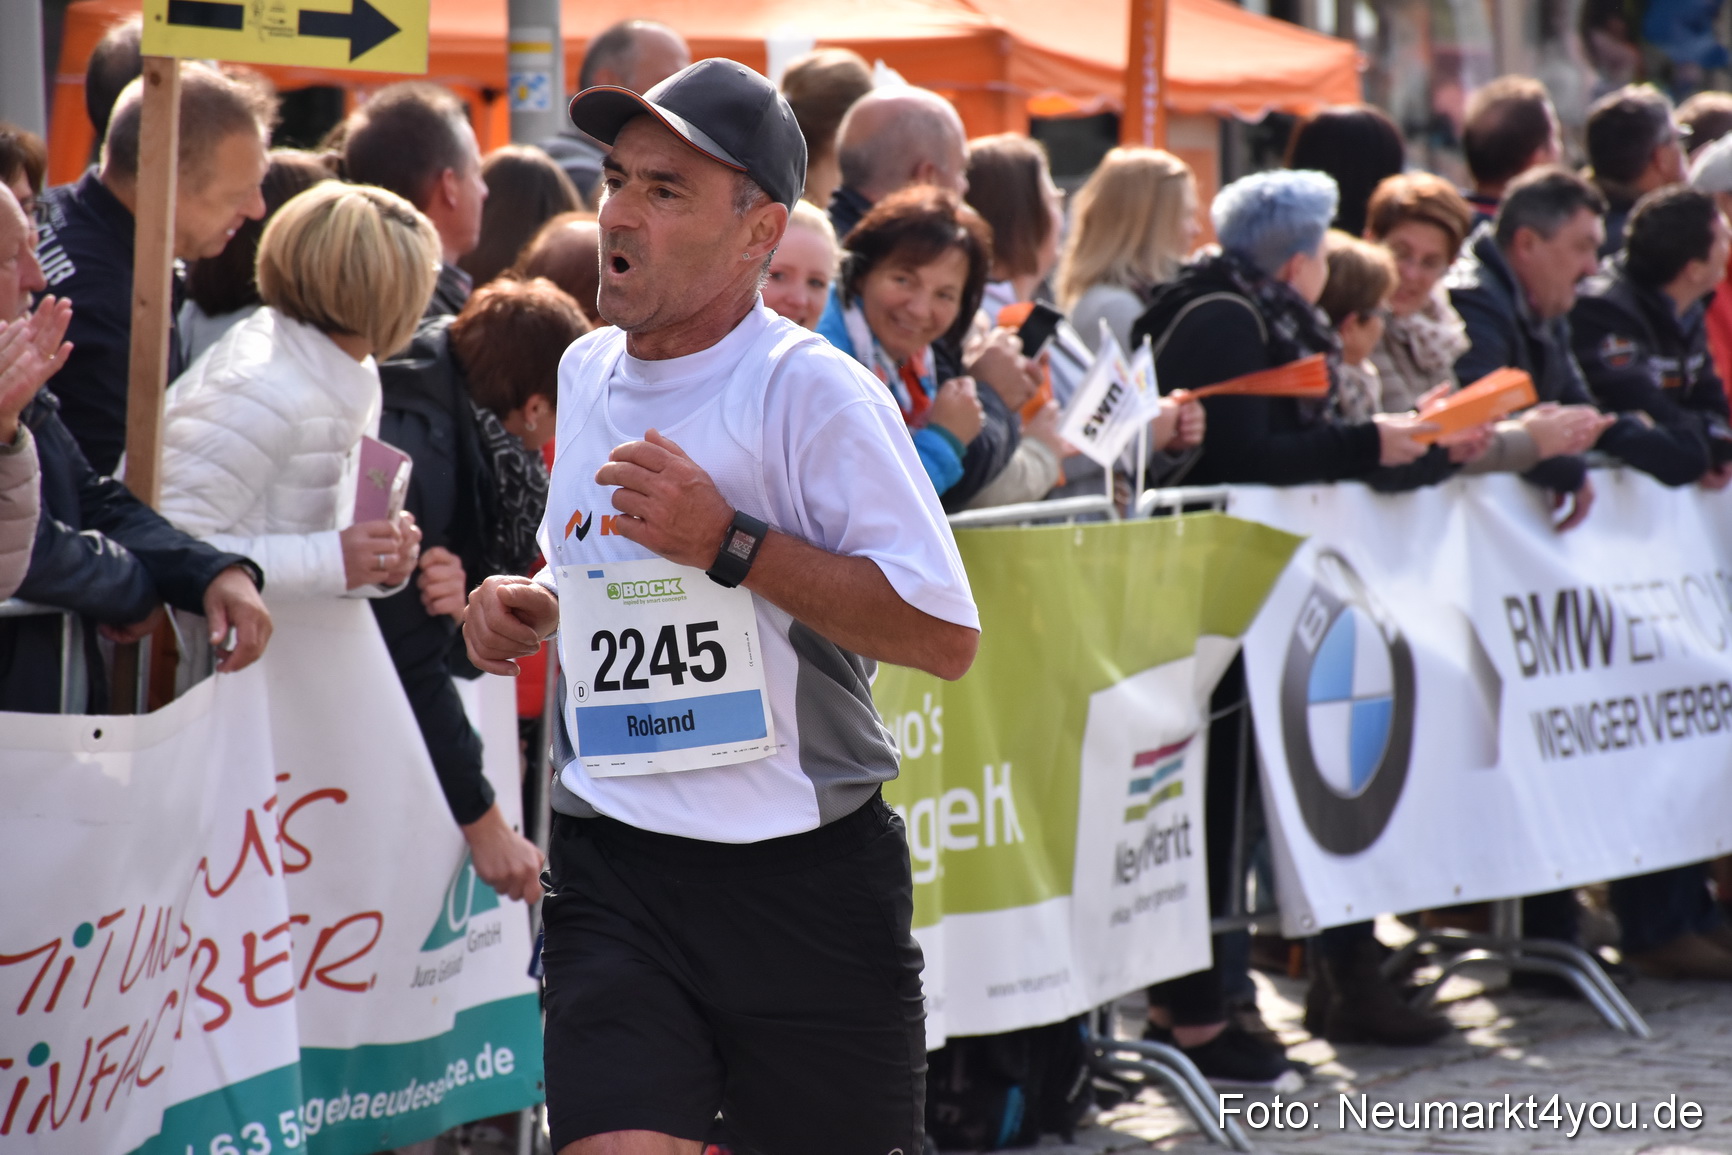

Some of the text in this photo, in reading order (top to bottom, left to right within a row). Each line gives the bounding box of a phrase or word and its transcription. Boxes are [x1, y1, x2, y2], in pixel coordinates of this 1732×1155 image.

[1083, 382, 1124, 442] swn
[621, 577, 685, 599] BOCK
[646, 596, 661, 604] smart
[662, 595, 687, 603] concepts
[1503, 584, 1614, 679] BMW
[590, 620, 727, 693] 2245
[578, 685, 585, 698] D
[627, 709, 695, 738] Roland
[1529, 693, 1647, 763] WENIGER
[466, 919, 502, 953] GmbH
